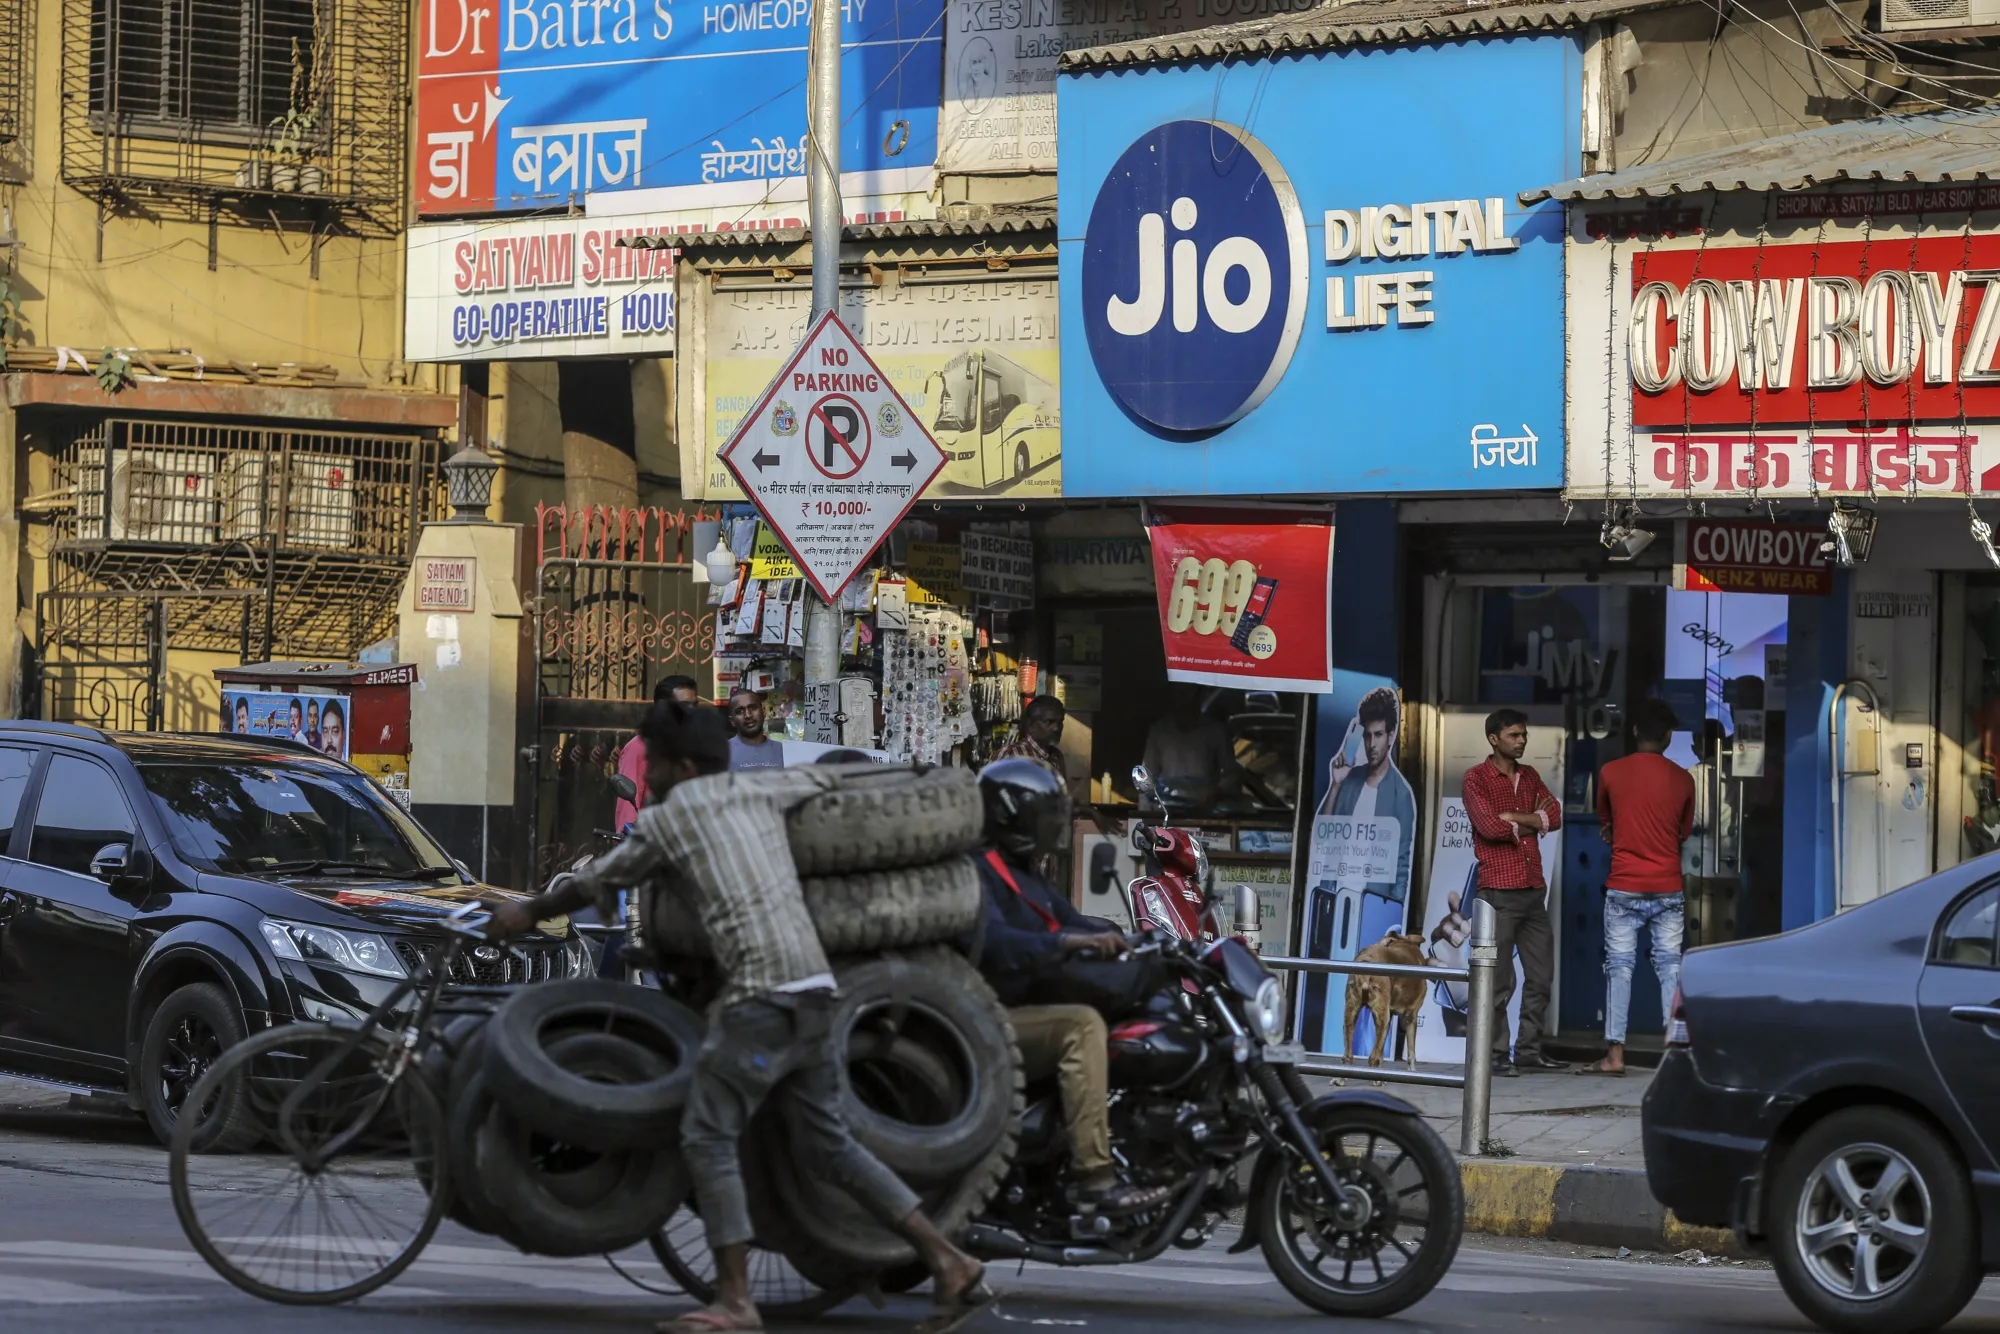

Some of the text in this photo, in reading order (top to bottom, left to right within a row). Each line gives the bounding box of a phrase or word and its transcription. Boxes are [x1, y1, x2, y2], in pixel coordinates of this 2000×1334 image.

[425, 0, 490, 58] Dr
[703, 0, 867, 34] HOMEOPHY
[1005, 91, 1057, 112] BANGAL
[959, 117, 1019, 139] BELGAUM
[989, 142, 1022, 160] ALL
[1778, 197, 1808, 215] SHOP
[1841, 195, 1885, 213] SATYAM
[1888, 194, 1914, 211] BLD.
[1915, 192, 1946, 209] NEAR
[1948, 190, 1976, 207] SION
[1325, 197, 1520, 260] DIGITAL
[454, 236, 574, 294] SATYAM
[1107, 197, 1272, 336] Jio
[1326, 271, 1435, 329] LIFE
[453, 295, 606, 345] CO-OPERATIVE
[1630, 270, 2000, 391] COWBOYZ
[821, 348, 849, 367] NO
[793, 373, 879, 392] PARKING
[1470, 424, 1538, 469] जियो
[709, 473, 727, 488] AIR
[769, 480, 788, 495] मीटर
[816, 501, 872, 517] 10,000/-
[962, 533, 1033, 558] Jio RECHARGE
[1693, 526, 1826, 567] COWBOYZ
[962, 551, 979, 568] Jio
[427, 563, 464, 582] SATYAM
[769, 566, 794, 577] IDEA
[908, 567, 960, 580] VODAFON
[1700, 570, 1756, 587] MENZ
[1762, 573, 1818, 590] WEAR
[421, 587, 444, 605] GATE
[924, 592, 951, 603] IDEA
[1167, 556, 1258, 637] 699
[1681, 622, 1735, 658] Galaxy
[1317, 821, 1352, 840] OPPO
[1356, 823, 1377, 842] F15
[1444, 821, 1459, 834] 90
[1316, 843, 1342, 855] Flaunt
[1352, 845, 1370, 857] Your
[1371, 846, 1390, 859] Way
[1442, 836, 1462, 848] Like
[1219, 866, 1275, 884] TRAVEL
